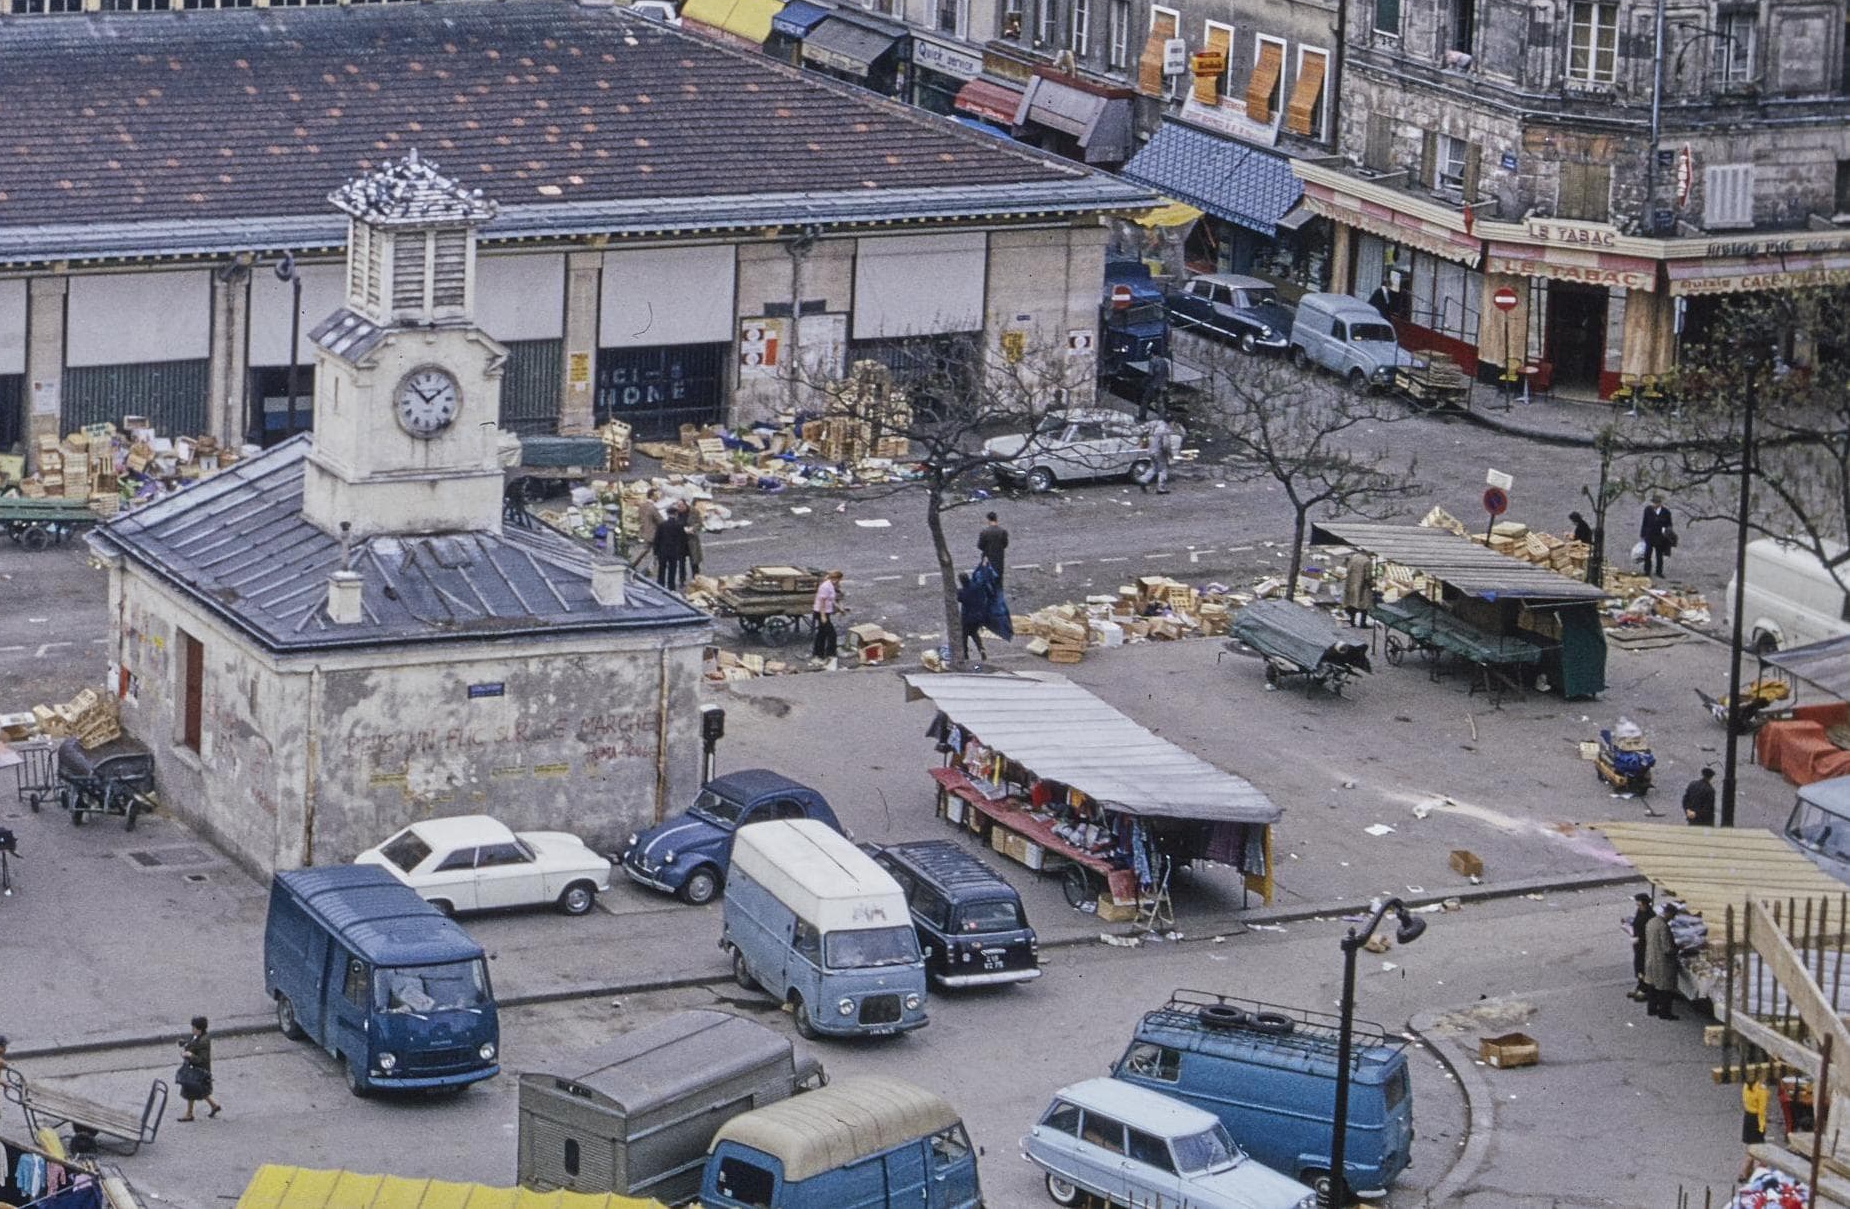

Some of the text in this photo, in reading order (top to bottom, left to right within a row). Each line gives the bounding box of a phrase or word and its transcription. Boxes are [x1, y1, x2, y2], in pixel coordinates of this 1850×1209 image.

[918, 41, 943, 61] Quick
[1529, 224, 1615, 248] LE TABAC
[1504, 260, 1639, 286] LE TABAC
[446, 727, 485, 750] FLIC
